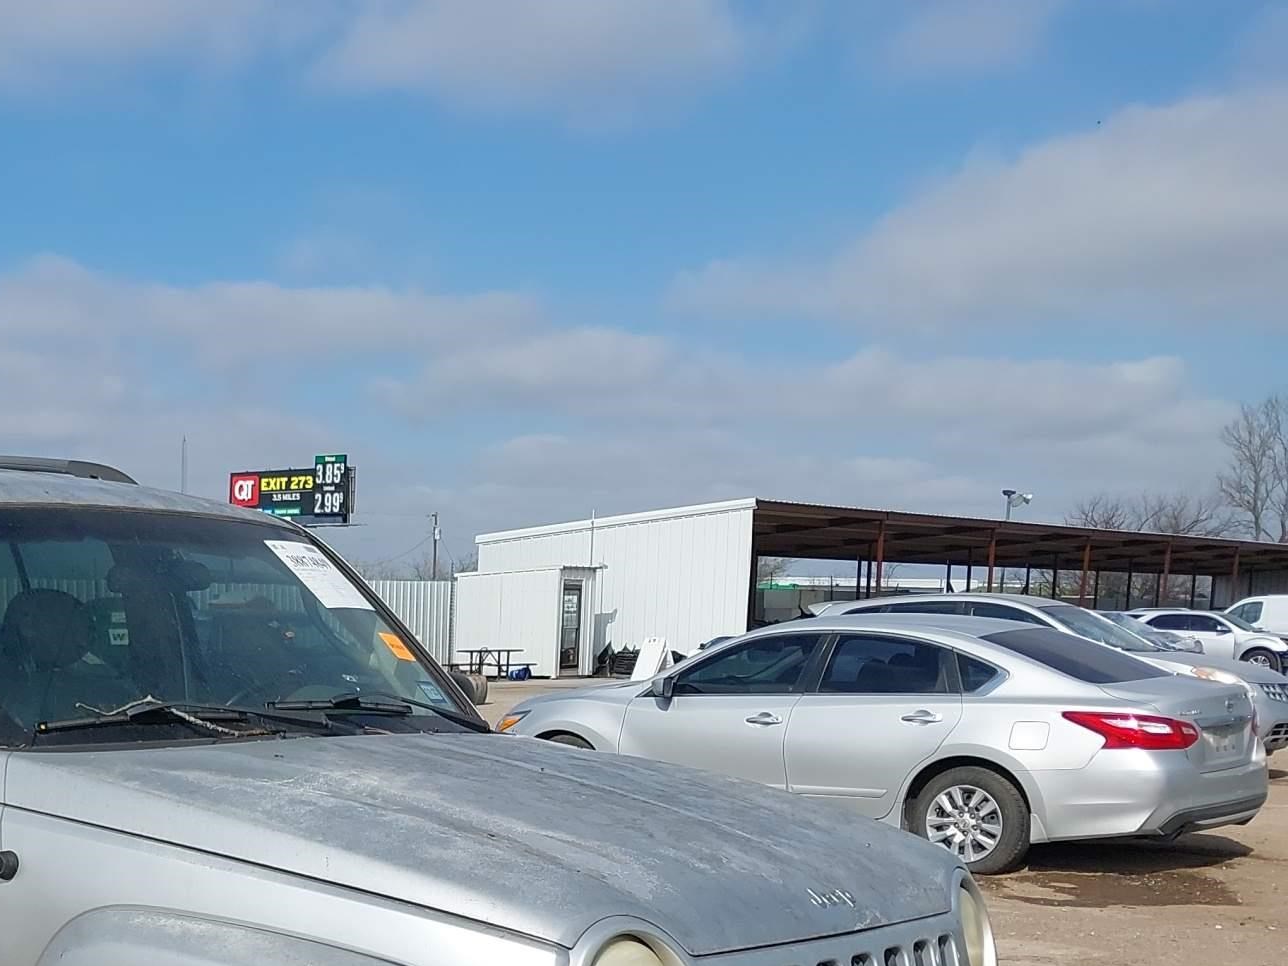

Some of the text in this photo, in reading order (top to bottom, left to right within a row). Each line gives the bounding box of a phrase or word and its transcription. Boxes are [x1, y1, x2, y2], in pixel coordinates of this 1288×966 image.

[234, 480, 254, 501] QT
[261, 477, 288, 491] EXIT
[290, 475, 313, 489] 273
[283, 493, 300, 501] MILES
[806, 888, 854, 909] Jeep
